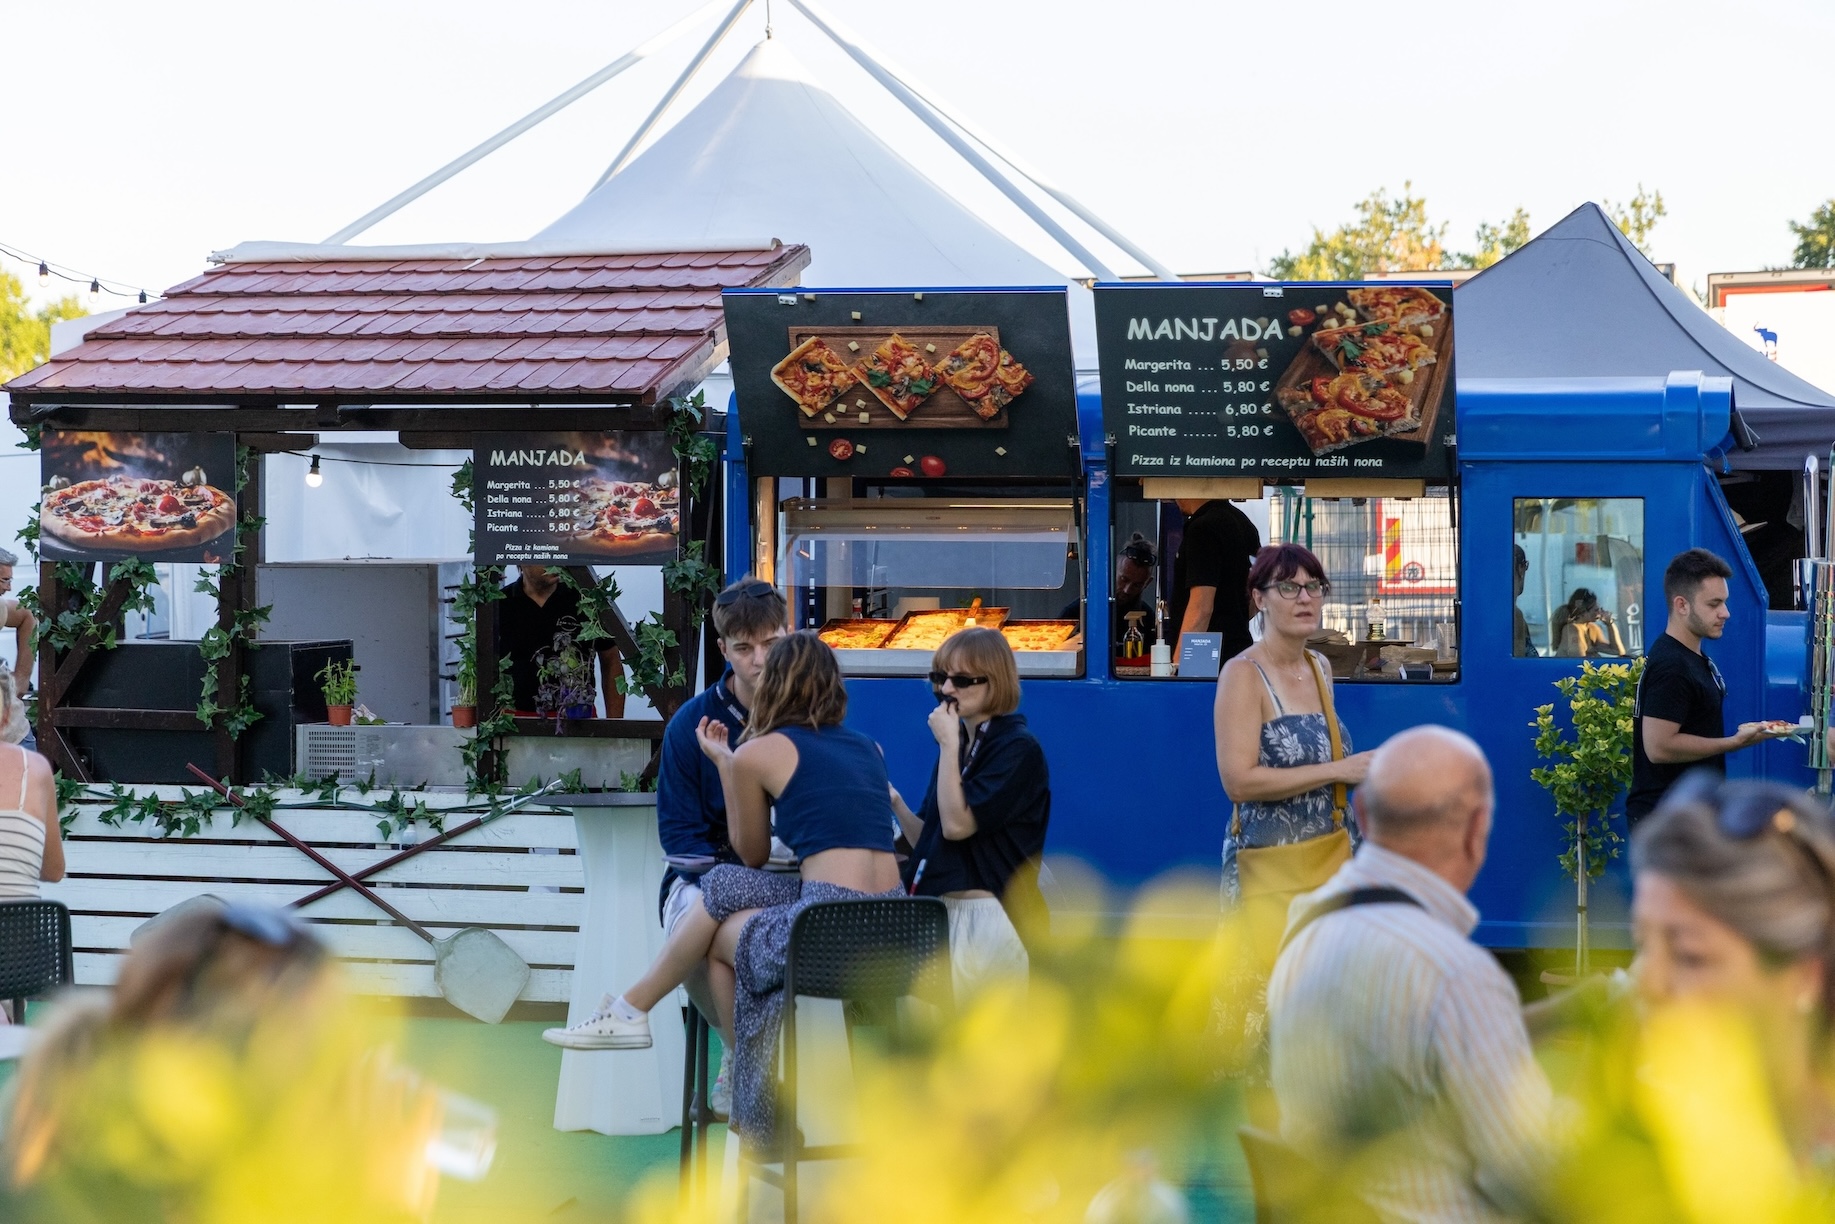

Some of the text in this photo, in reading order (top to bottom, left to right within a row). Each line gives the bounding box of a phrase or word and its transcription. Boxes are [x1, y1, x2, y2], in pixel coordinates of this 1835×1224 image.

[1127, 317, 1284, 341] MANJADA
[1124, 358, 1191, 373] Margerita
[1221, 358, 1253, 372] 5,50
[1257, 358, 1268, 370] €
[1126, 381, 1159, 393] Della
[1165, 385, 1195, 393] nona
[1223, 381, 1255, 394] 5,80
[1259, 381, 1270, 392] €
[1127, 403, 1182, 415] Istriana
[1225, 403, 1257, 416] 6,80
[1261, 403, 1272, 414] €
[1128, 425, 1177, 437] Picante
[1227, 425, 1259, 438] 5,80
[1263, 425, 1274, 436] €
[490, 449, 586, 467] MANJADA
[1131, 454, 1383, 469] Pizza iz kamiona po receptu naših nona
[487, 480, 531, 491] Margerita
[548, 480, 570, 489] 5,50
[572, 480, 580, 489] €
[487, 494, 509, 503] Della
[548, 494, 570, 504] 5,80
[572, 494, 580, 503] €
[487, 509, 523, 518] Istriana
[548, 508, 570, 518] 6,80
[572, 508, 580, 517] €
[487, 523, 519, 532] Picante
[548, 523, 570, 532] 5,80
[572, 523, 580, 531] €
[505, 543, 559, 551] Pizza iz kamiona
[496, 553, 504, 561] po
[506, 553, 532, 561] receptu
[533, 551, 551, 560] naših
